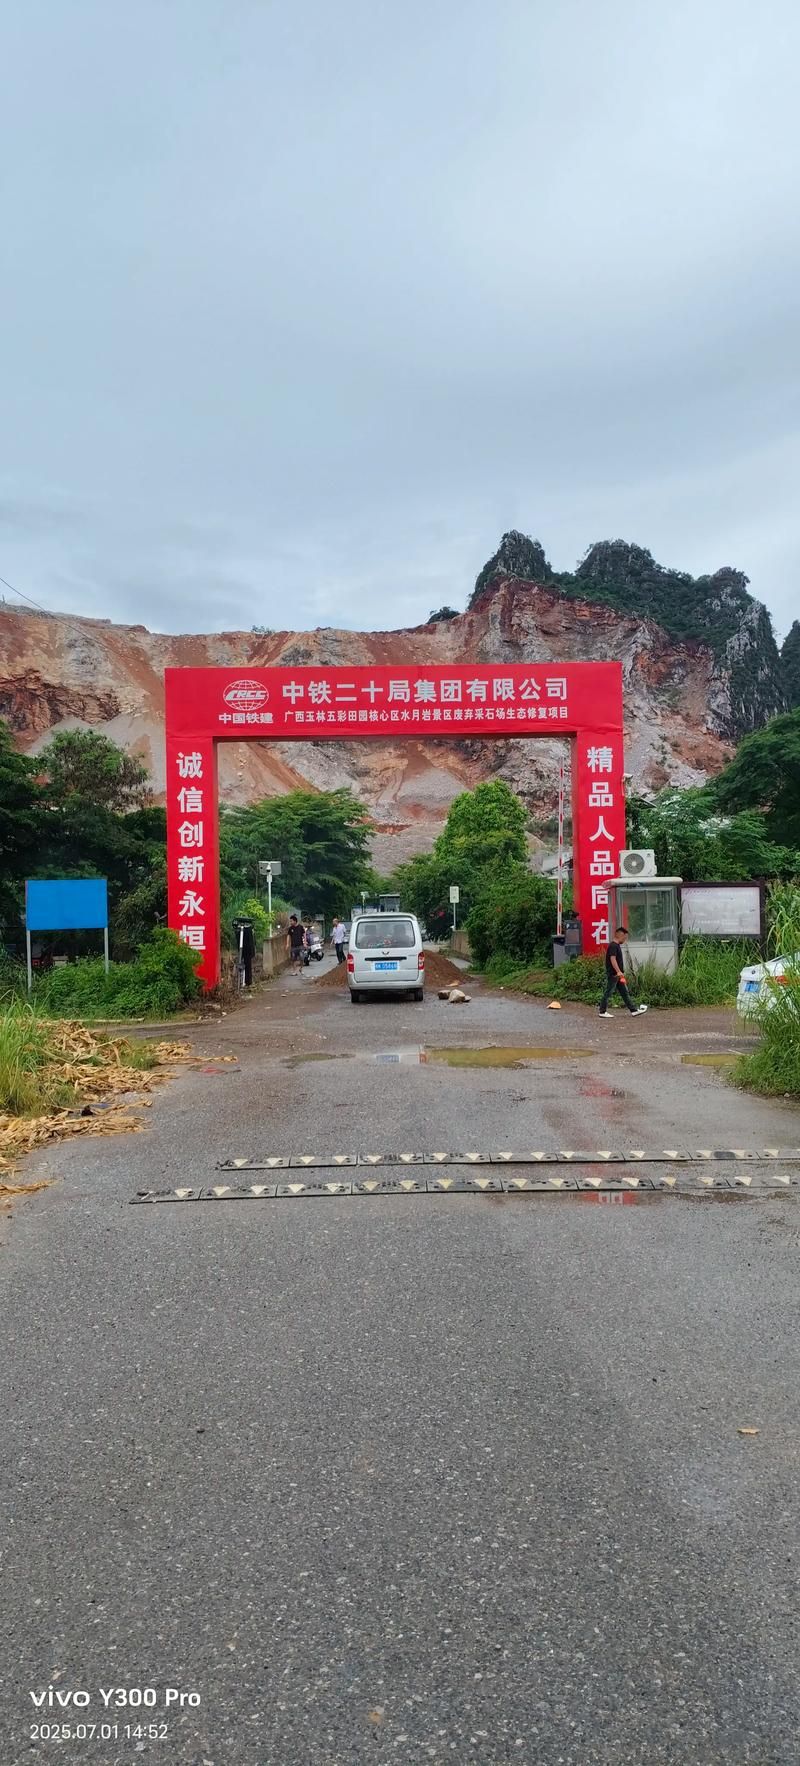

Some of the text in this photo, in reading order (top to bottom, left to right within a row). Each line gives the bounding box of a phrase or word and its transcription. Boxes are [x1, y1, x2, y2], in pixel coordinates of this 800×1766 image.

[225, 690, 267, 701] CRCC
[282, 678, 568, 705] 中铁二十局集团有限公司
[218, 712, 274, 724] 中国铁建
[284, 706, 568, 723] 广西玉林五彩田园核心区水月岩景区废弃采石场生态修复项目
[176, 752, 207, 951] 诚信创新永恒
